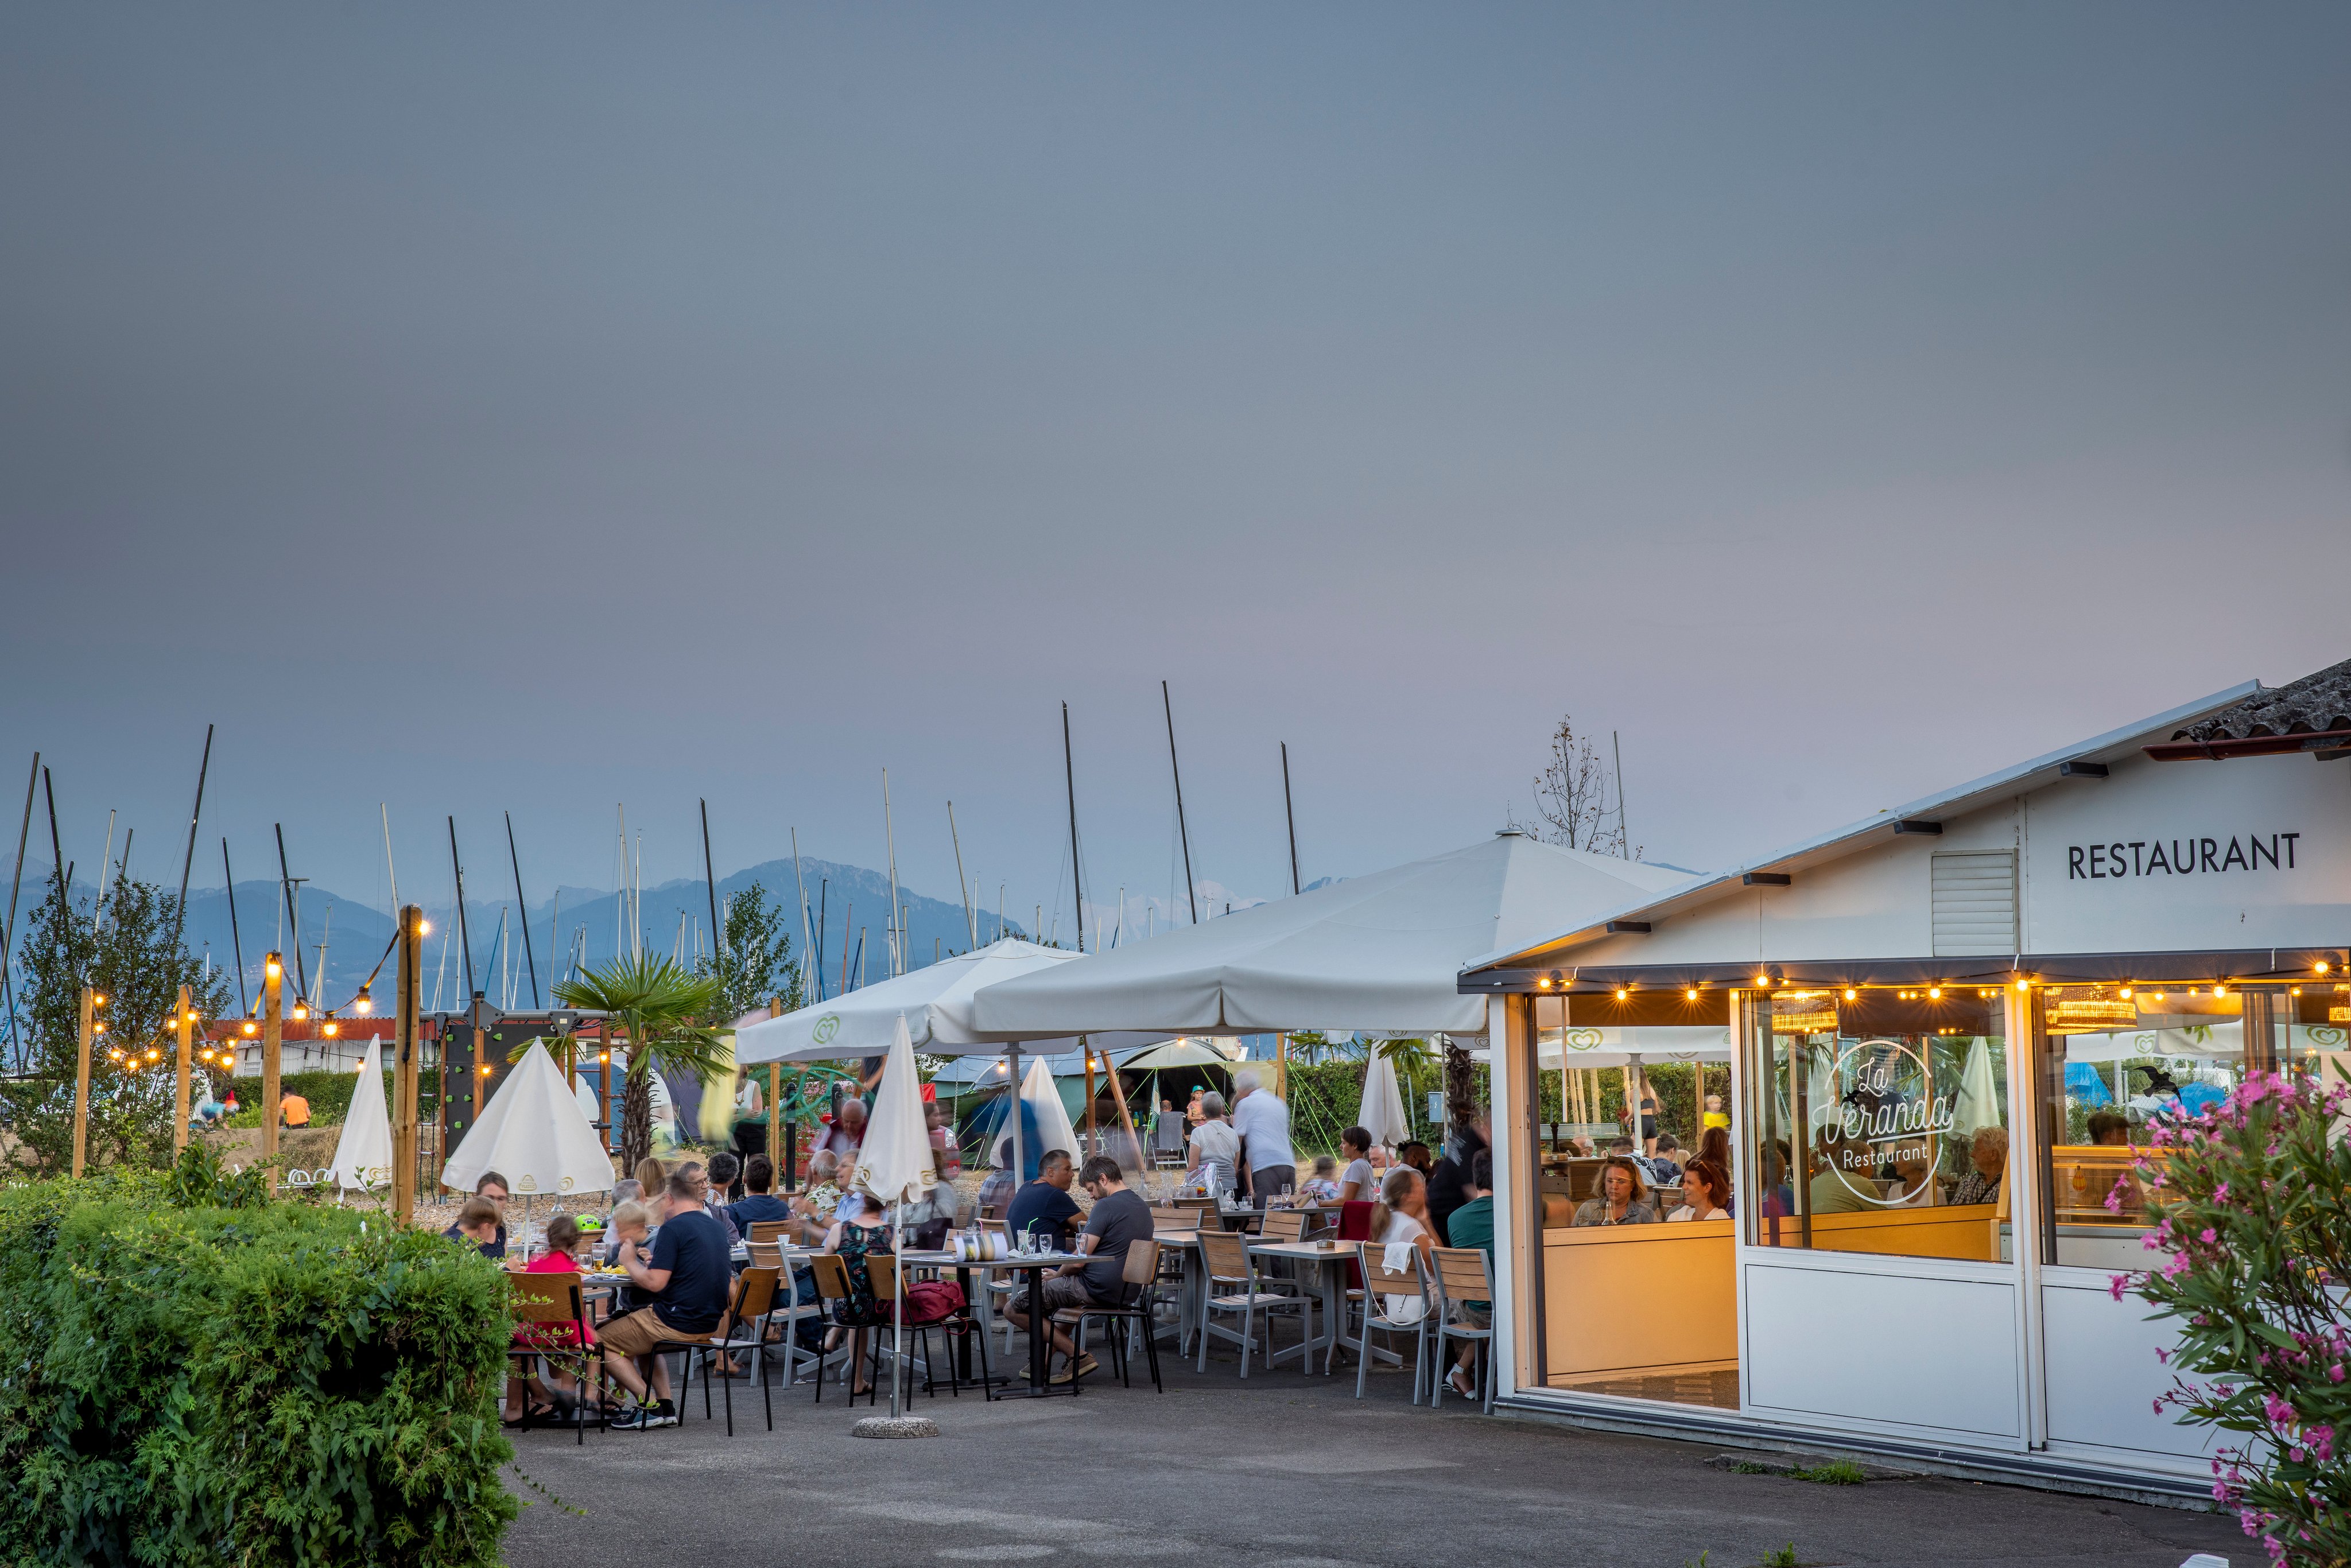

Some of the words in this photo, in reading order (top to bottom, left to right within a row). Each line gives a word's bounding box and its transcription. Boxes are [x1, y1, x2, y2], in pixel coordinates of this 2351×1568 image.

[2069, 833, 2300, 879] RESTAURANT
[1857, 1057, 1888, 1097] La
[1812, 1089, 1953, 1144] Veranda
[1844, 1144, 1928, 1168] Restaurant
